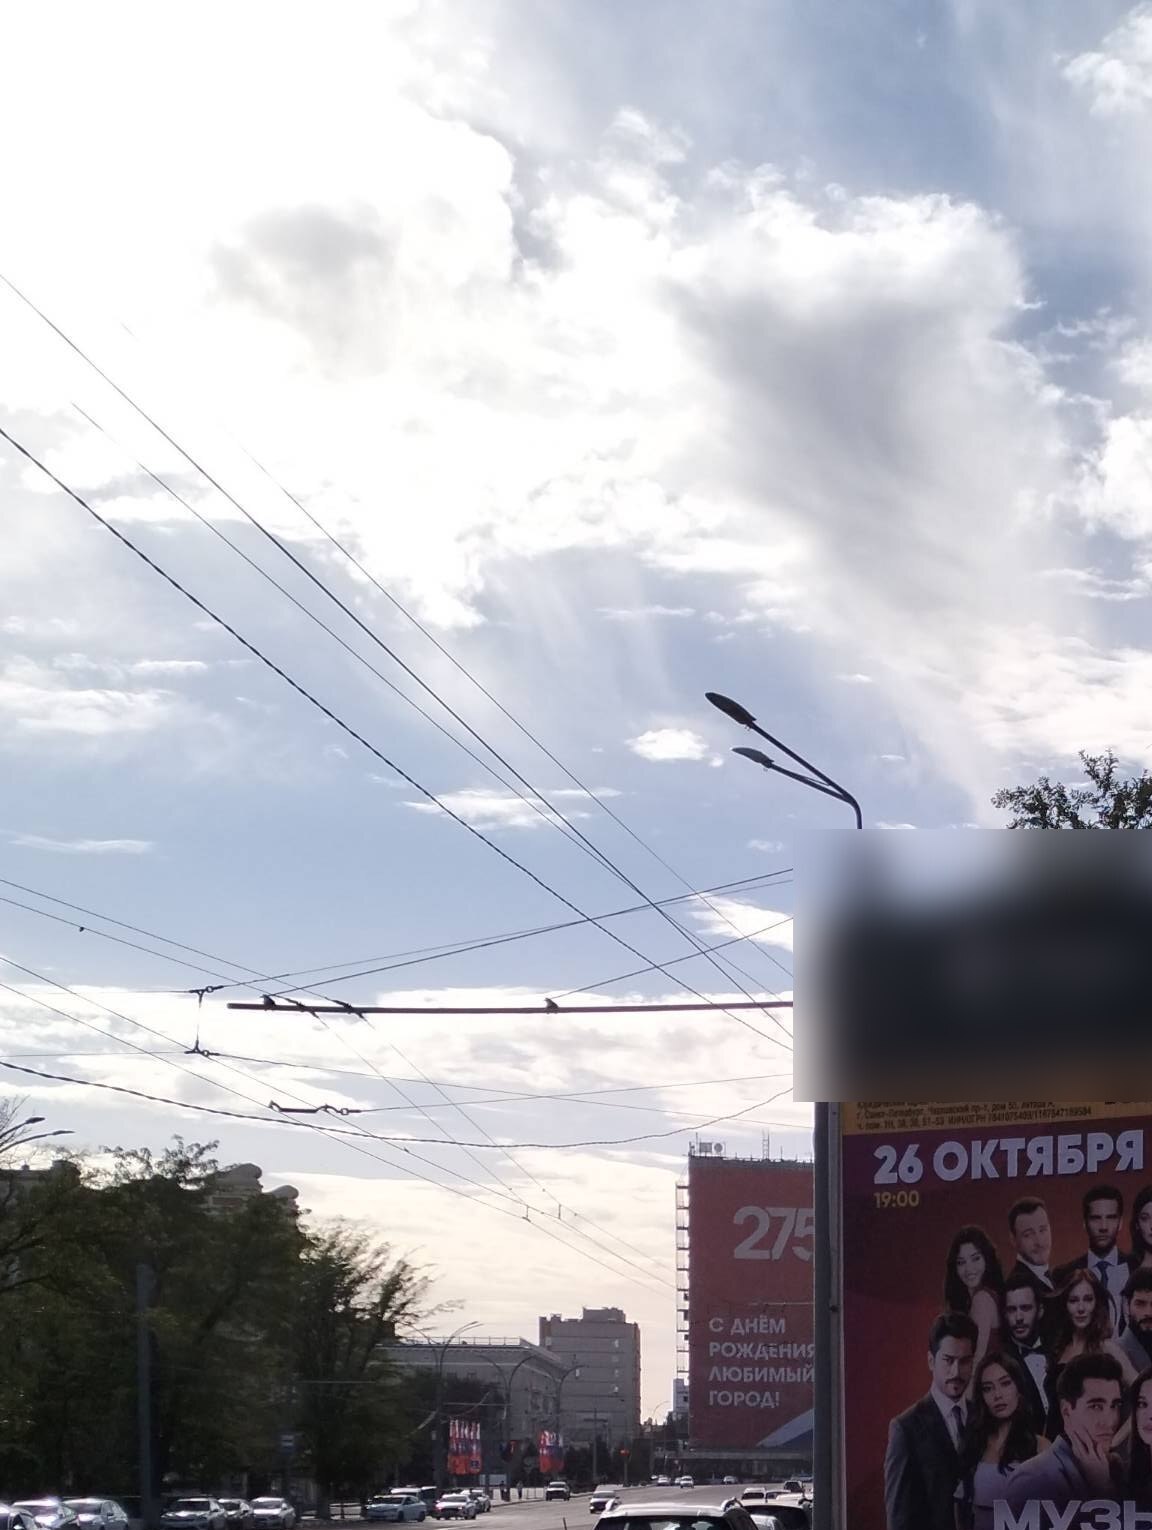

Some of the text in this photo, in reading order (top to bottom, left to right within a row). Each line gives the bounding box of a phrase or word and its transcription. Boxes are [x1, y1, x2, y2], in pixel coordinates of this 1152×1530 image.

[874, 1129, 1145, 1185] 26 ОКТЯБРЯ
[874, 1190, 920, 1209] 19:00
[709, 1315, 785, 1335] С ДНЁМ
[709, 1342, 815, 1360] РОЖДЕНИЯ
[709, 1364, 815, 1383] ЛЮБИМЫЙ
[709, 1390, 780, 1409] ГОРОД!
